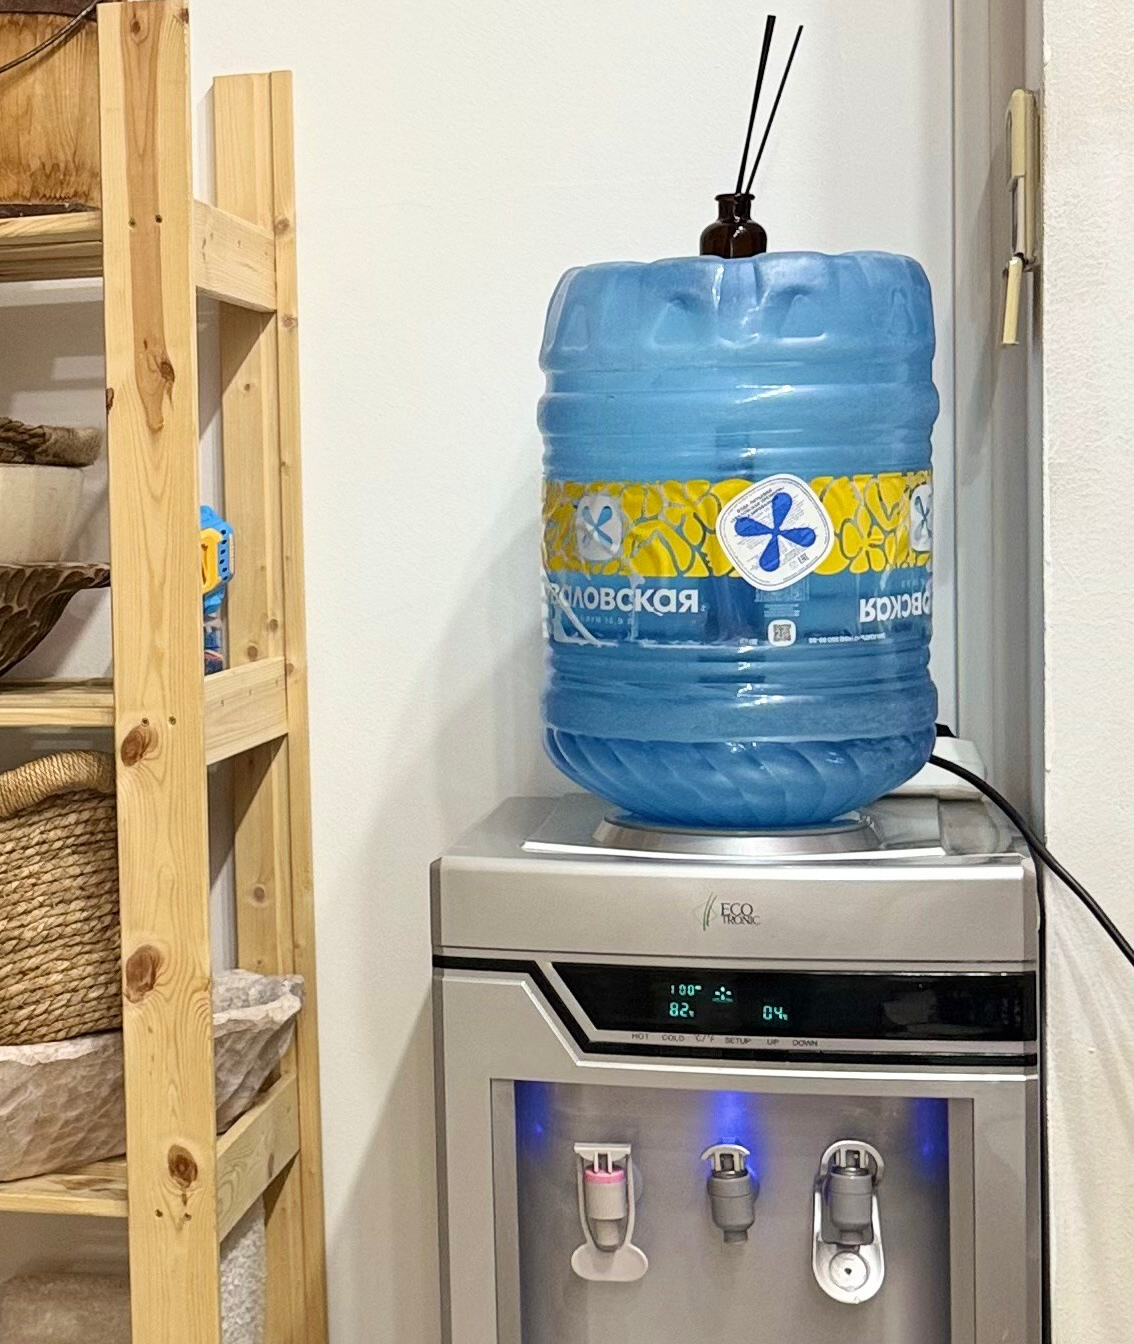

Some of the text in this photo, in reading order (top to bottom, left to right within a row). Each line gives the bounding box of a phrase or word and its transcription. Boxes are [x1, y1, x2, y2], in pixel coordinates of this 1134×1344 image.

[720, 902, 754, 917] ECO
[722, 915, 761, 926] TRONIC
[631, 1032, 649, 1040] HOT
[661, 1034, 685, 1042] COLD
[725, 1037, 752, 1045] SETUP
[766, 1038, 779, 1046] UP
[792, 1039, 818, 1047] DOWN
